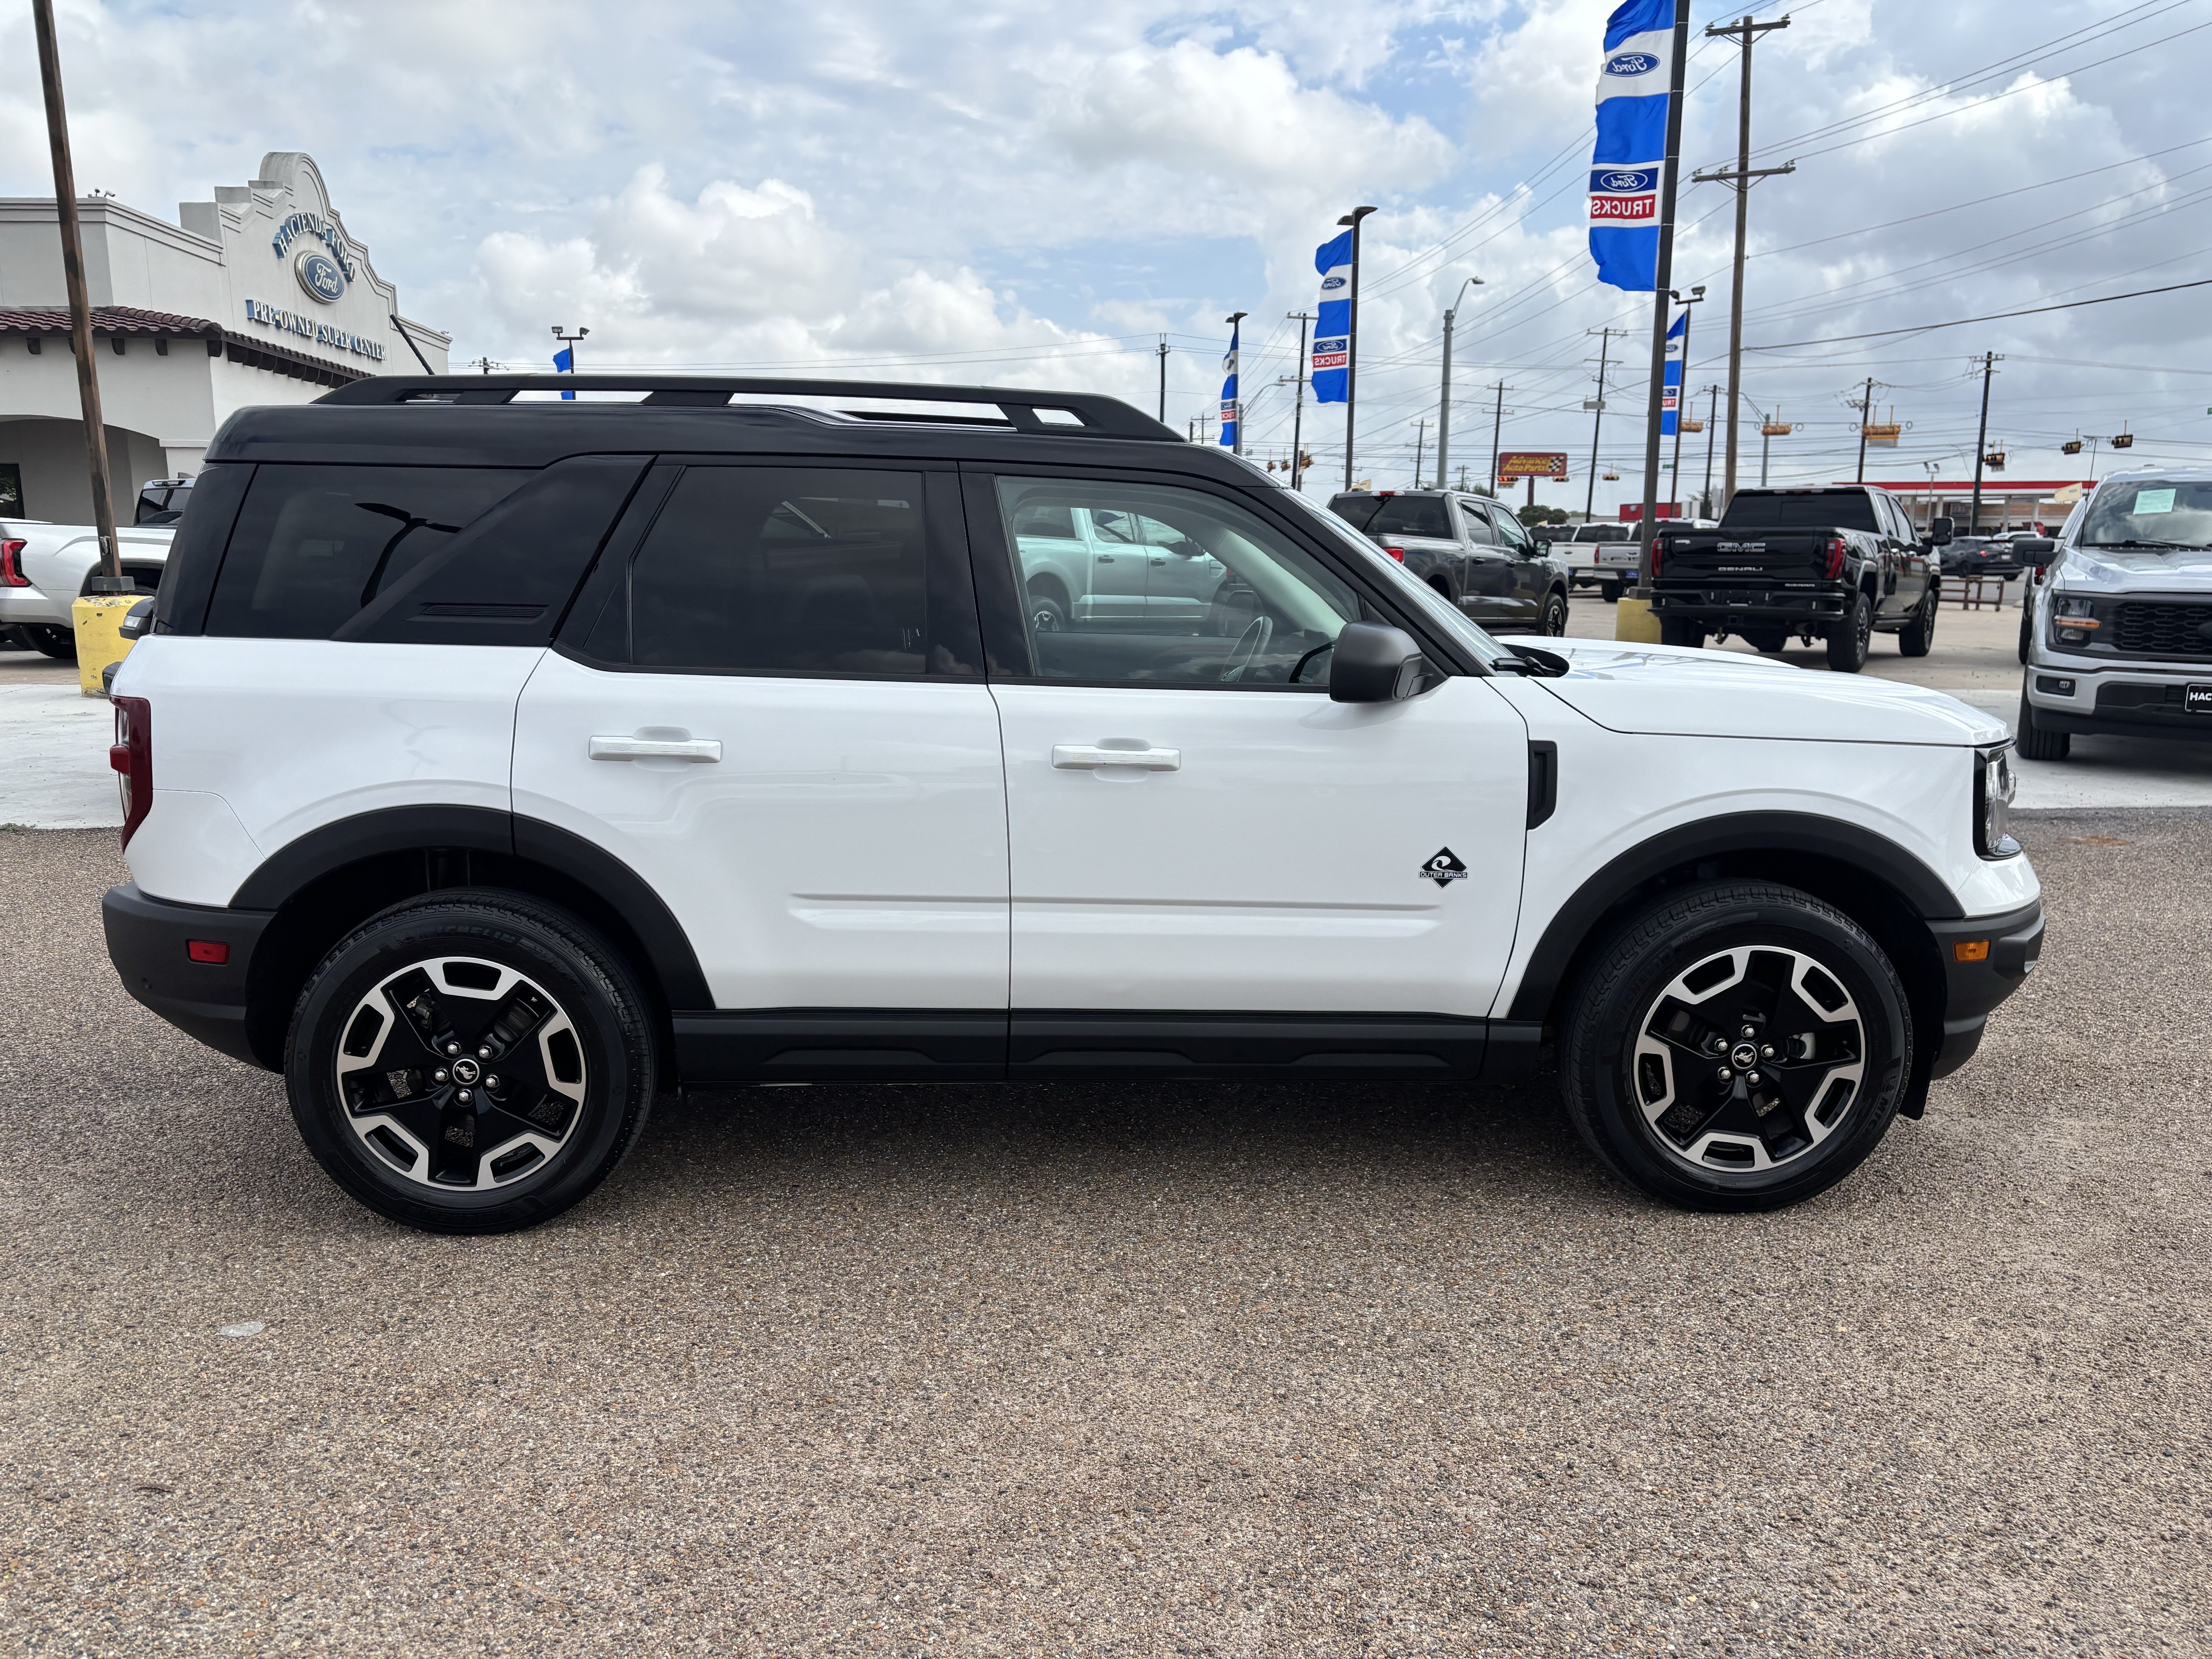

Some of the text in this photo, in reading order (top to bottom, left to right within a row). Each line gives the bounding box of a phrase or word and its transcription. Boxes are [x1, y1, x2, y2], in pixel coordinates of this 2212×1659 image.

[278, 213, 356, 282] HACIENDA FORD
[315, 263, 338, 294] Ford
[252, 300, 388, 361] PRE-OWNED SUPER CENTER
[1717, 542, 1766, 553] GMC
